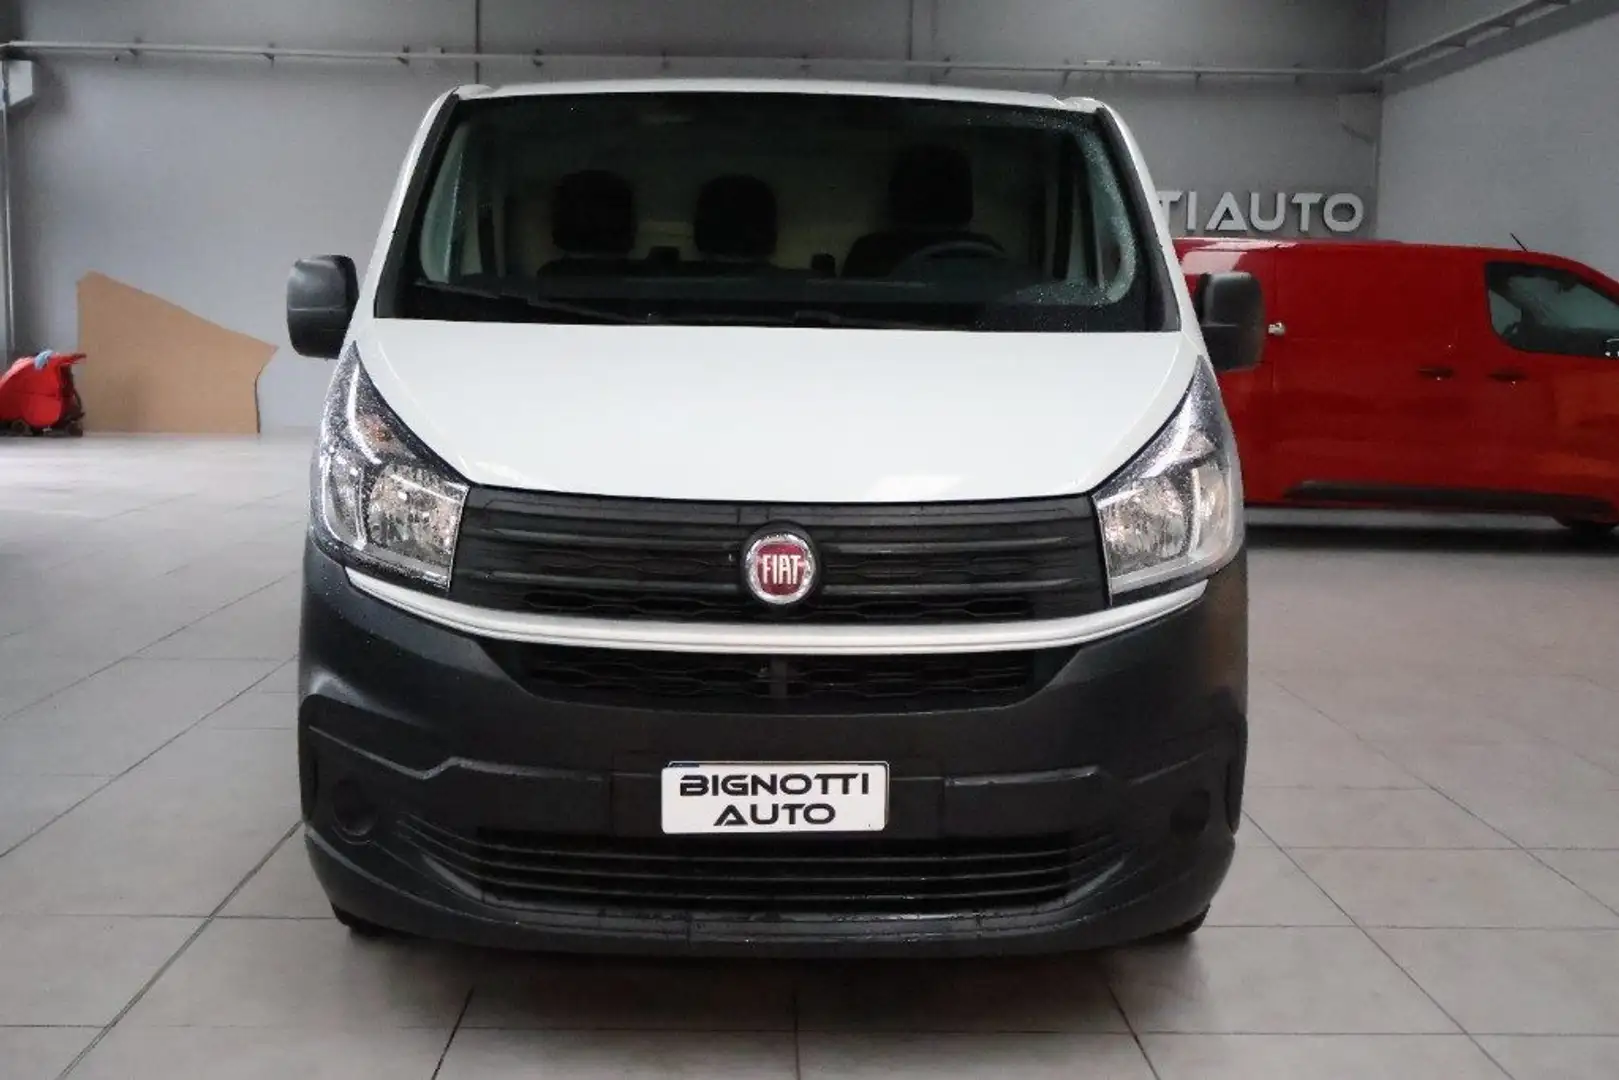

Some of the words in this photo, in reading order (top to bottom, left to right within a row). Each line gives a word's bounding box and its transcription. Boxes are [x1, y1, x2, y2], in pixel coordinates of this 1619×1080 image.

[1205, 191, 1364, 233] AUTO
[762, 554, 801, 585] FIAT
[680, 773, 869, 797] BIGNOTTI
[713, 803, 836, 827] AUTO
